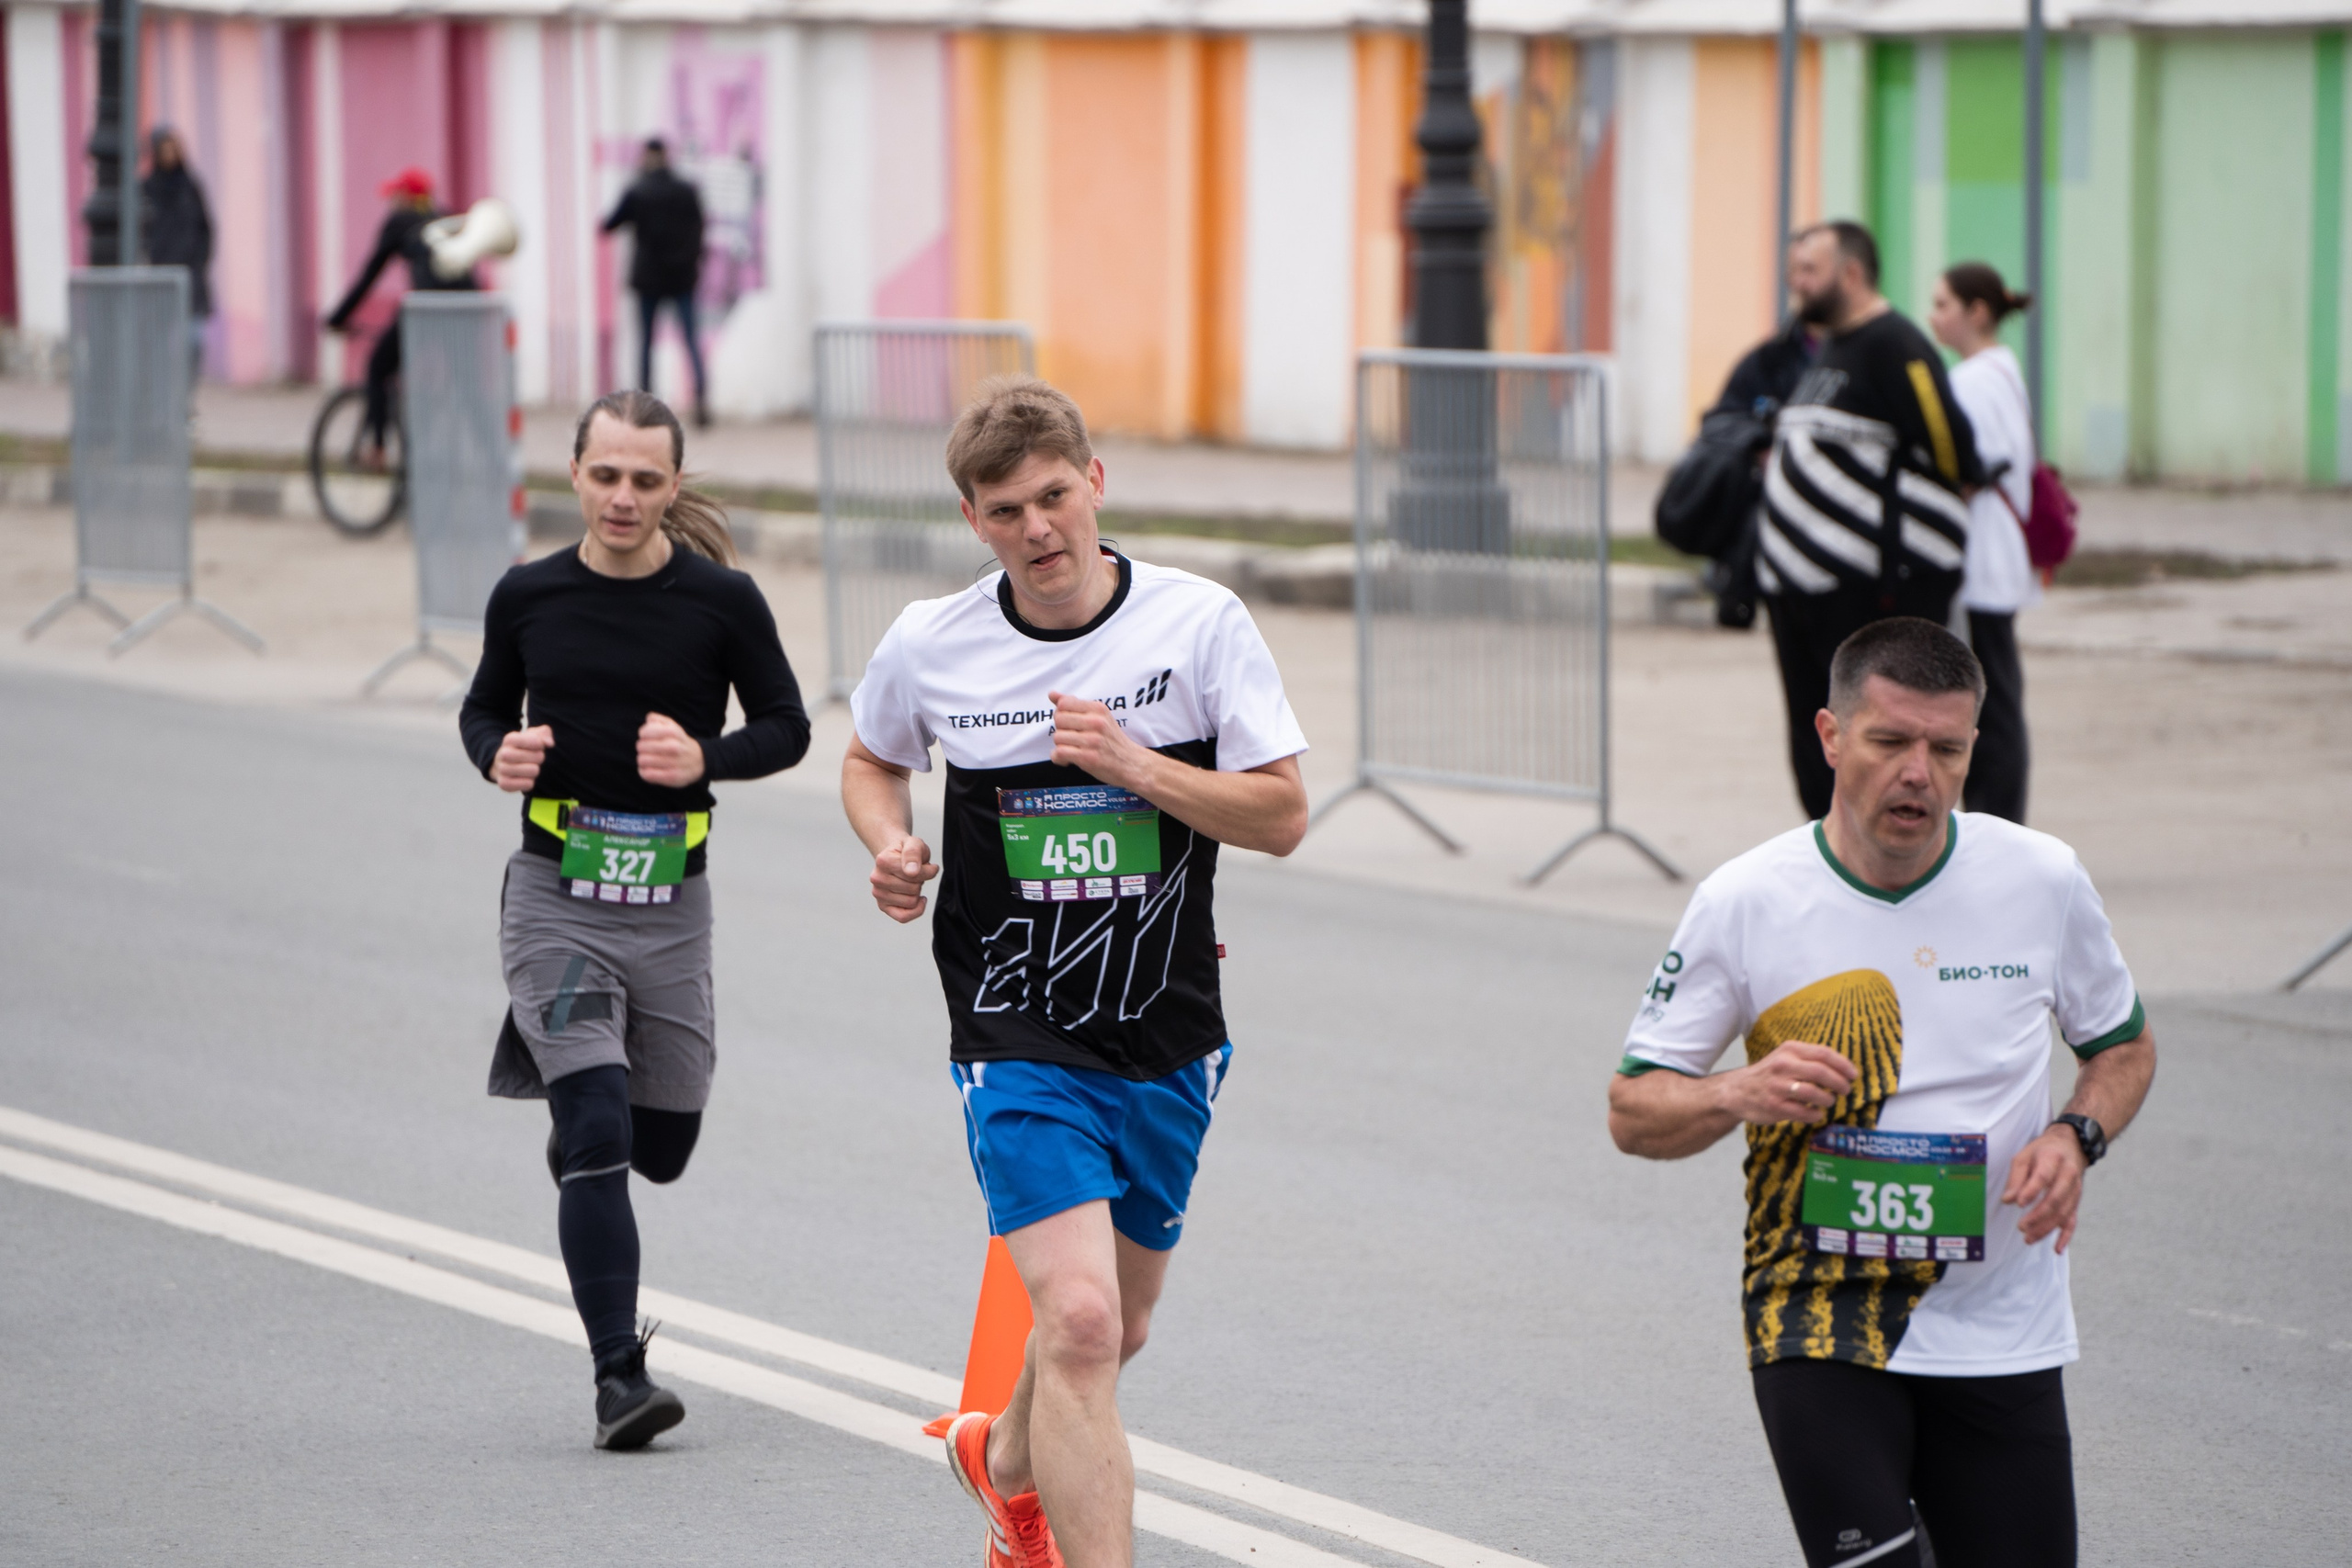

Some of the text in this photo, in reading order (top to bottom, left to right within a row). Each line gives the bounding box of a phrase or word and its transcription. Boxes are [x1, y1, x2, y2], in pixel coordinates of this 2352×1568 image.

[948, 696, 1126, 728] ТЕХНОДИНКА
[1044, 799, 1107, 809] КОСМОС
[1054, 792, 1107, 801] ПРОСТО
[599, 847, 656, 884] 327
[1041, 831, 1117, 874] 450
[1850, 1179, 1934, 1231] 363
